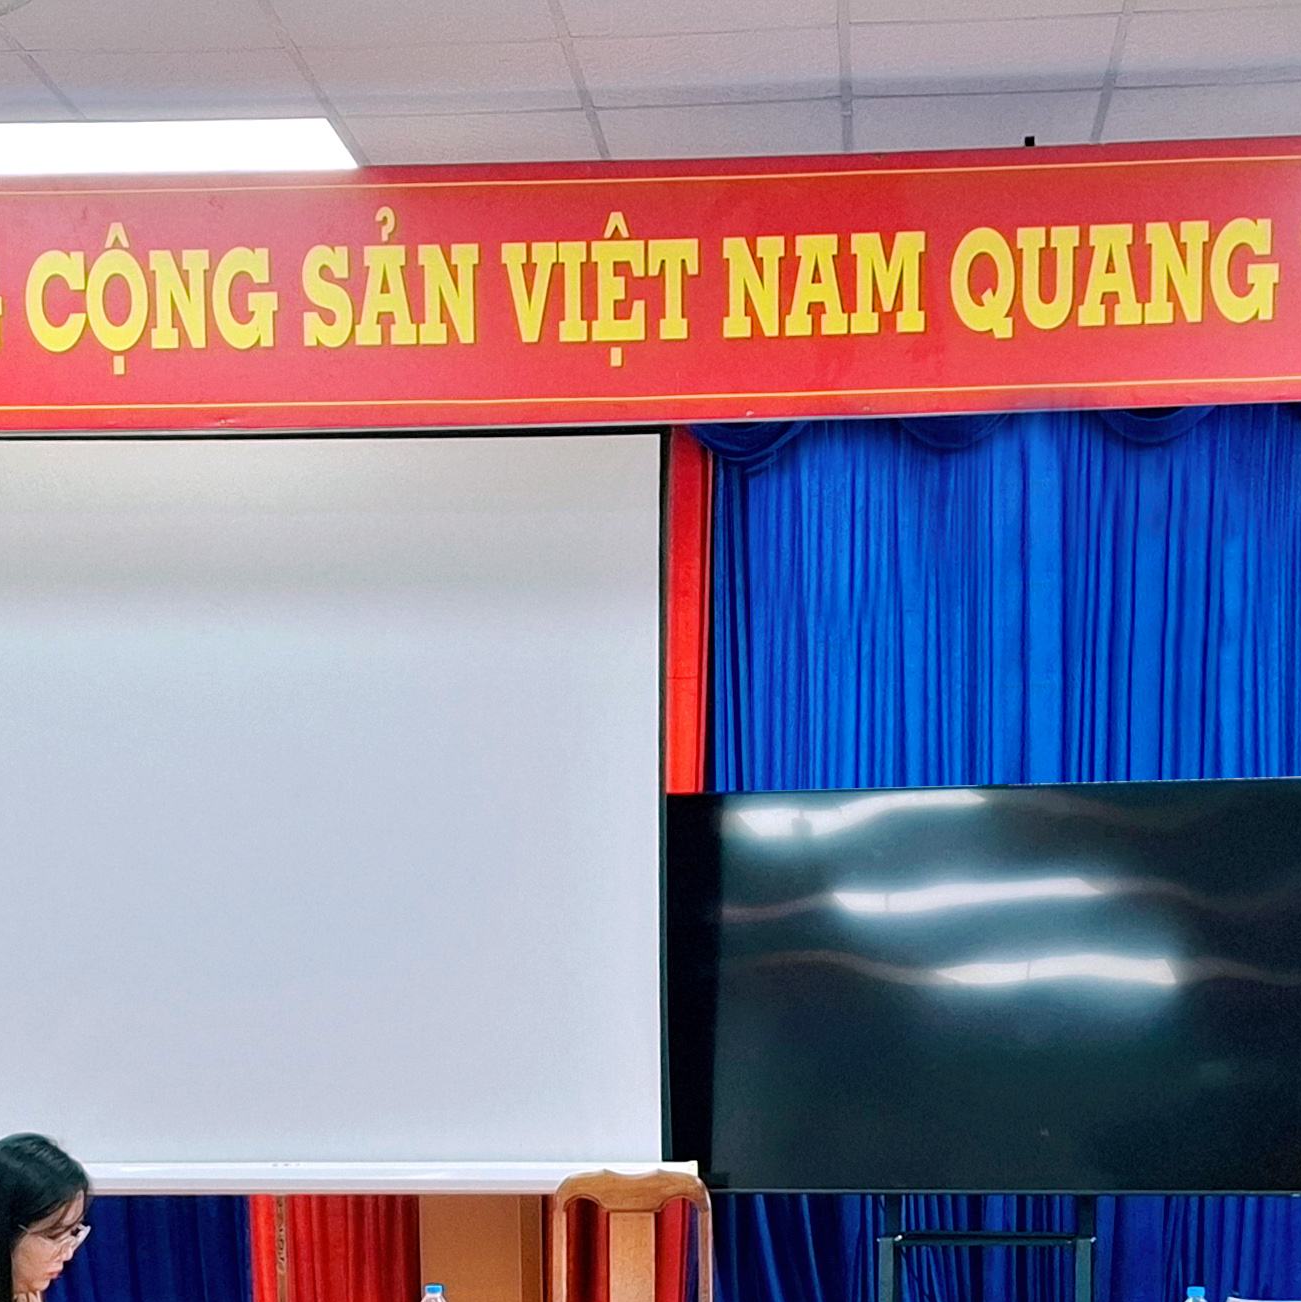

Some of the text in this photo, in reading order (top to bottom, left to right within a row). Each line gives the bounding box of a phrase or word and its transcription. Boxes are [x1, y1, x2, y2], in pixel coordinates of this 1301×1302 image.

[24, 221, 279, 376] CỘNG
[302, 207, 478, 348] SẢN
[502, 213, 698, 366] VIỆT
[723, 232, 925, 337] NAM
[951, 218, 1279, 338] QUANG
